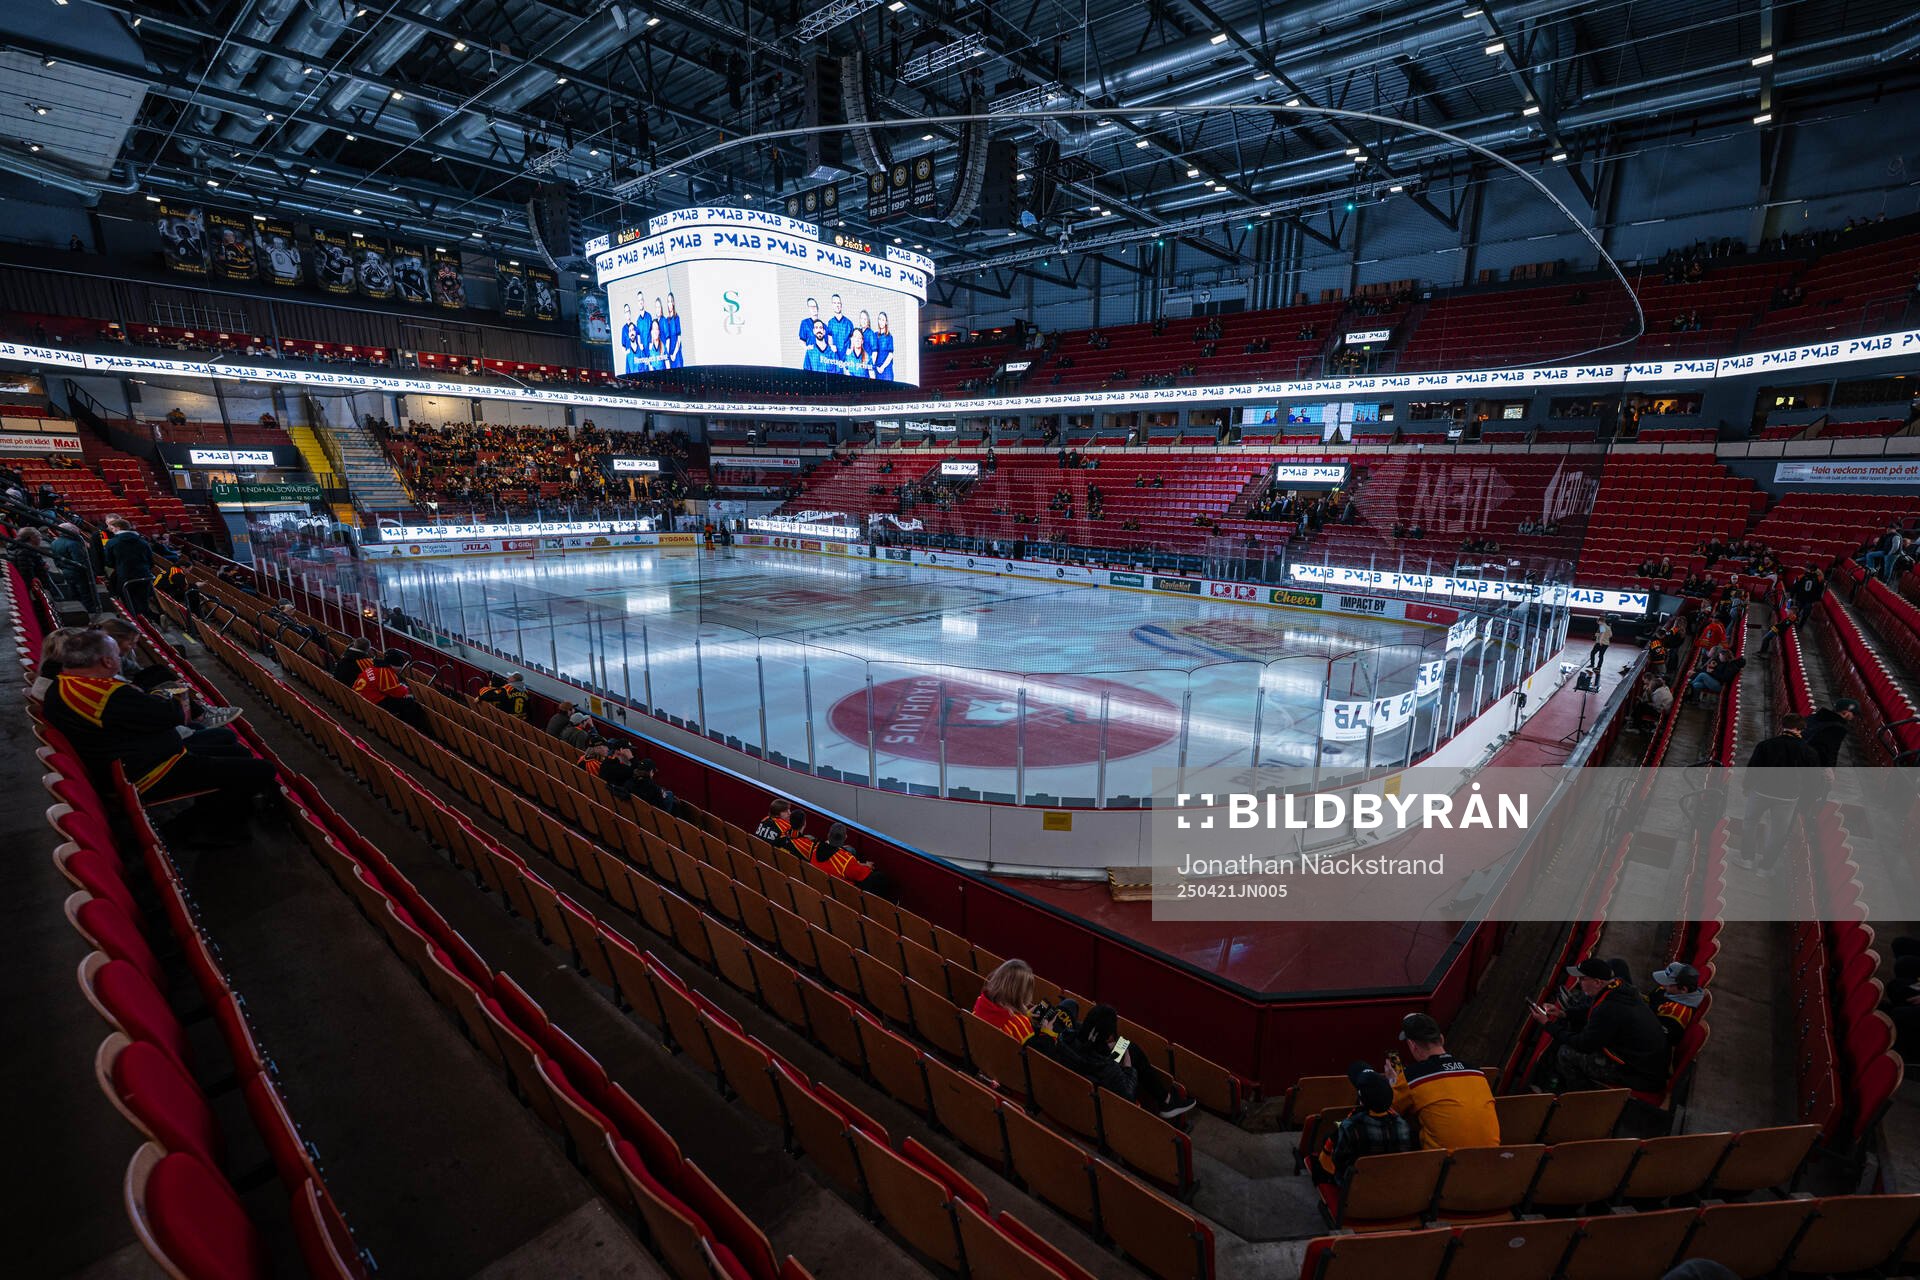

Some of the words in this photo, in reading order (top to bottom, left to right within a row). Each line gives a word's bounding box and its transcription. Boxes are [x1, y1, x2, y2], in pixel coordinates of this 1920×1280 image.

[651, 216, 668, 230] PMAB
[673, 210, 699, 222] PMAB
[707, 209, 743, 220] PMAB
[748, 212, 782, 226] PMAB
[790, 220, 818, 235] PMAB
[844, 240, 862, 251] 26:03
[888, 248, 910, 260] PMAB
[618, 251, 638, 267] PMAB
[643, 242, 665, 258] PMAB
[670, 234, 702, 251] PMAB
[714, 233, 760, 249] PMAB
[767, 238, 807, 258] PMAB
[817, 250, 852, 268] PMAB
[859, 260, 892, 278] PMAB
[900, 270, 923, 288] PMAB
[1722, 357, 1754, 371] PMAB
[1762, 351, 1797, 365] PMAB
[1801, 345, 1839, 359] PMAB
[1849, 338, 1892, 353] PMAB
[1902, 333, 1920, 347] PM
[0, 345, 15, 354] AB
[24, 348, 51, 358] PMAB
[56, 352, 82, 362] PMAB
[95, 357, 132, 367] PMAB
[138, 360, 173, 370] PMAB
[183, 364, 217, 374] PMAB
[225, 367, 257, 376] PMAB
[267, 370, 296, 379] PMAB
[306, 373, 334, 382] PMAB
[338, 376, 365, 384] PMAB
[373, 379, 399, 387] PMAB
[406, 381, 431, 389] PMAB
[438, 384, 462, 392] PMAB
[468, 386, 491, 394] PMAB
[548, 392, 568, 400] PMAB
[1154, 390, 1174, 398] PMAB
[1176, 389, 1197, 397] PMAB
[1202, 388, 1224, 396] PMAB
[1229, 386, 1251, 394] PMAB
[1258, 385, 1282, 393] PMAB
[1288, 382, 1313, 392] PMAB
[1316, 381, 1342, 390] PMAB
[1349, 379, 1376, 389] PMAB
[1382, 377, 1411, 387] PMAB
[1418, 375, 1448, 385] PMAB
[1456, 373, 1488, 384] PMAB
[1492, 372, 1525, 382] PMAB
[1533, 369, 1568, 380] PMAB
[1577, 367, 1613, 378] PMAB
[1624, 364, 1662, 375] PMAB
[1674, 362, 1715, 373] PMAB
[197, 452, 229, 460] PMAB
[1812, 466, 1830, 474] Hela
[1832, 466, 1867, 474] veckans
[1869, 466, 1888, 474] mat
[1889, 465, 1902, 476] på
[1905, 466, 1918, 474] ett
[383, 527, 407, 536] MAB
[1299, 566, 1334, 578] PMAB
[1345, 570, 1382, 582] PMAB
[1393, 573, 1433, 588] PMAB
[1445, 578, 1488, 592] PMAB
[1618, 594, 1647, 607] PM
[1274, 590, 1316, 606] Cheers
[1341, 596, 1372, 610] IMPACT
[1374, 600, 1386, 611] BY
[884, 680, 940, 745] BAUHAUS
